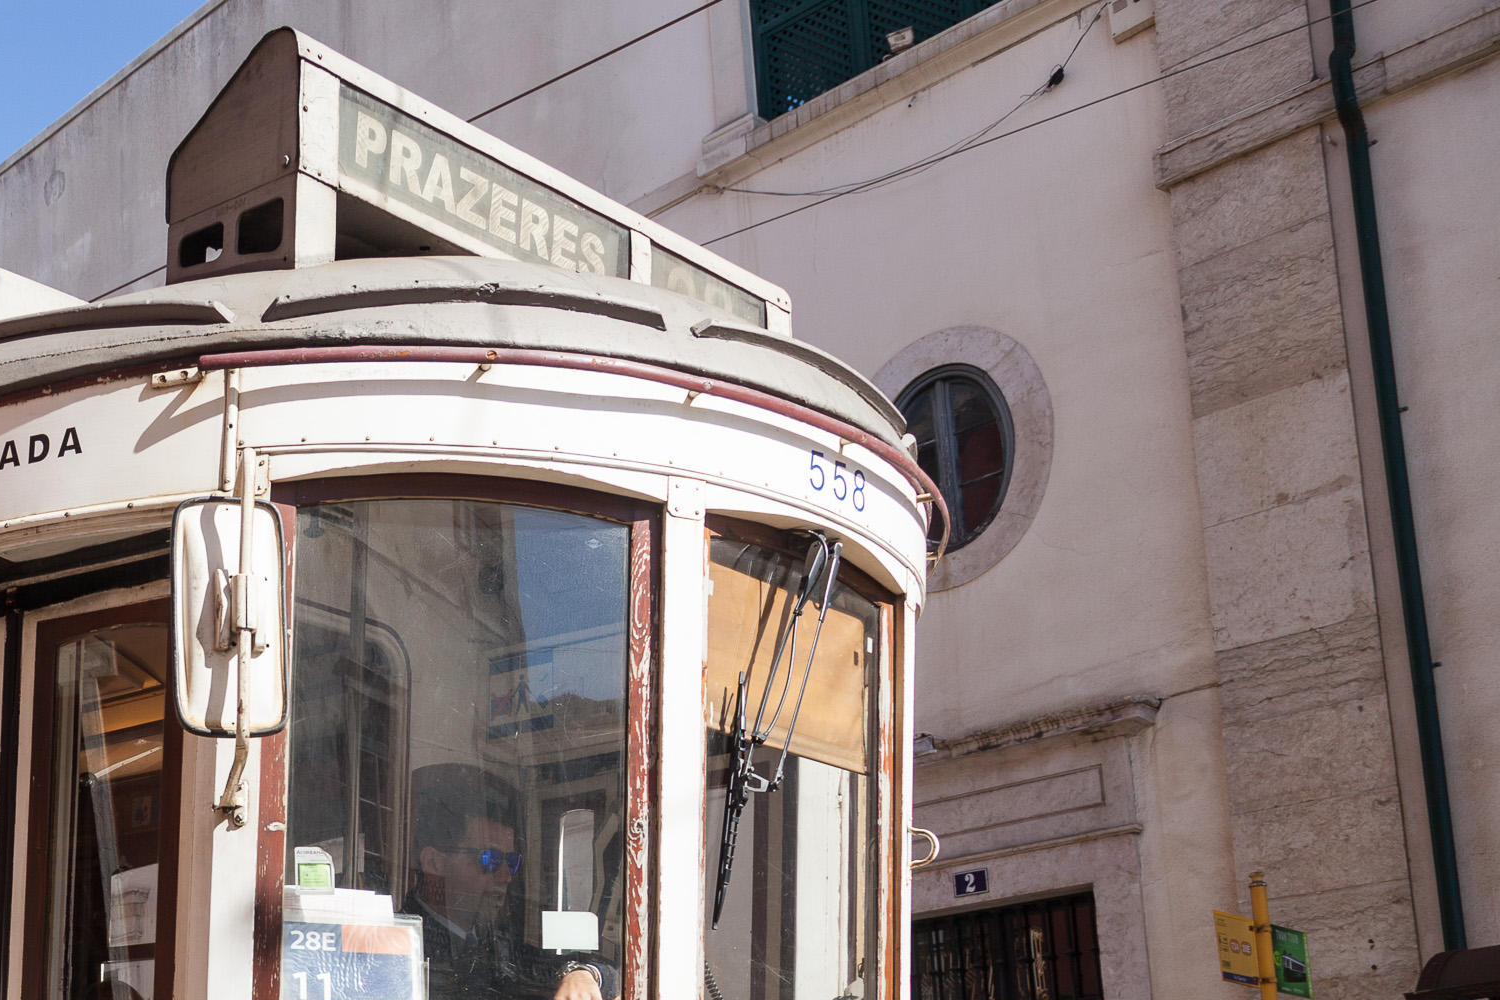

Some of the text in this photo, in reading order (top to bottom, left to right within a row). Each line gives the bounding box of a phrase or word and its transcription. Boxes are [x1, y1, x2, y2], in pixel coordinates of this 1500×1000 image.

[354, 110, 607, 276] PRAZERES
[809, 449, 866, 512] 558
[964, 873, 976, 893] 2
[290, 930, 337, 952] 28E
[292, 971, 333, 1000] 11
